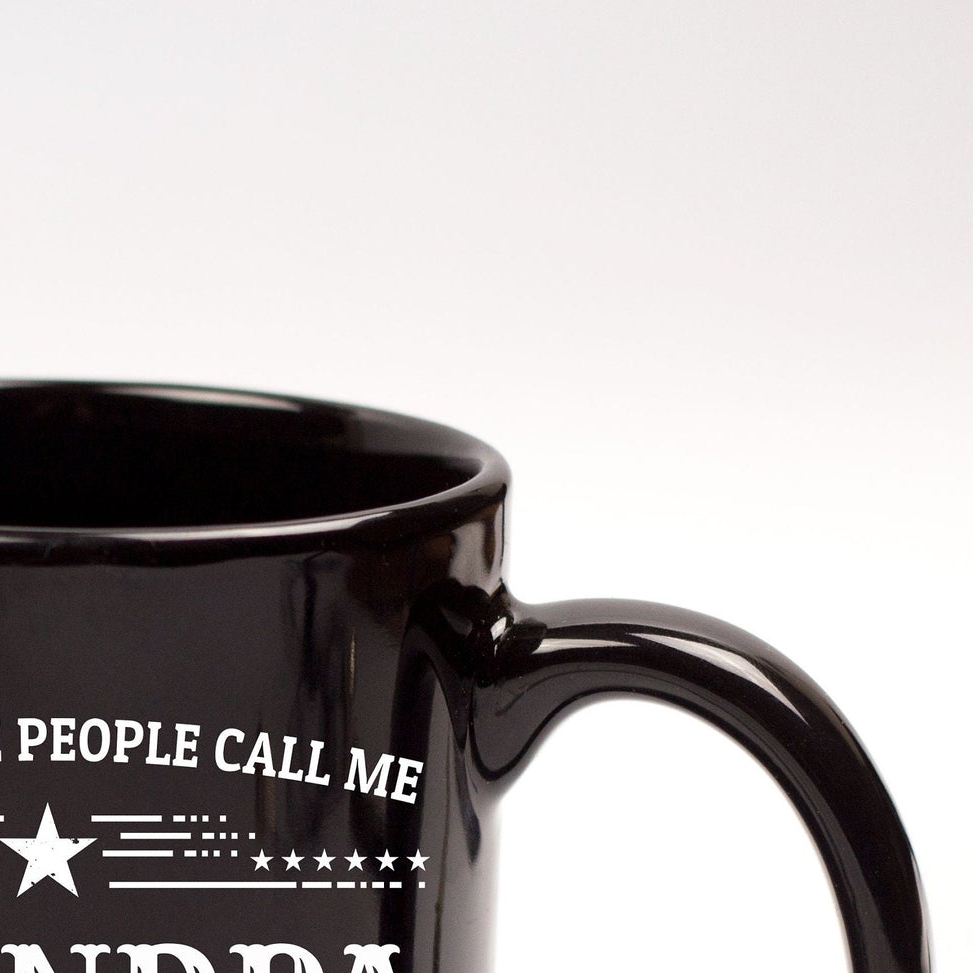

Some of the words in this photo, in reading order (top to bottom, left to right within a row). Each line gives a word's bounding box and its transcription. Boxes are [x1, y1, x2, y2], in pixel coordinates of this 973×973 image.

[18, 718, 200, 768] PEOPLE
[215, 728, 330, 786] CALL
[344, 747, 423, 804] ME
